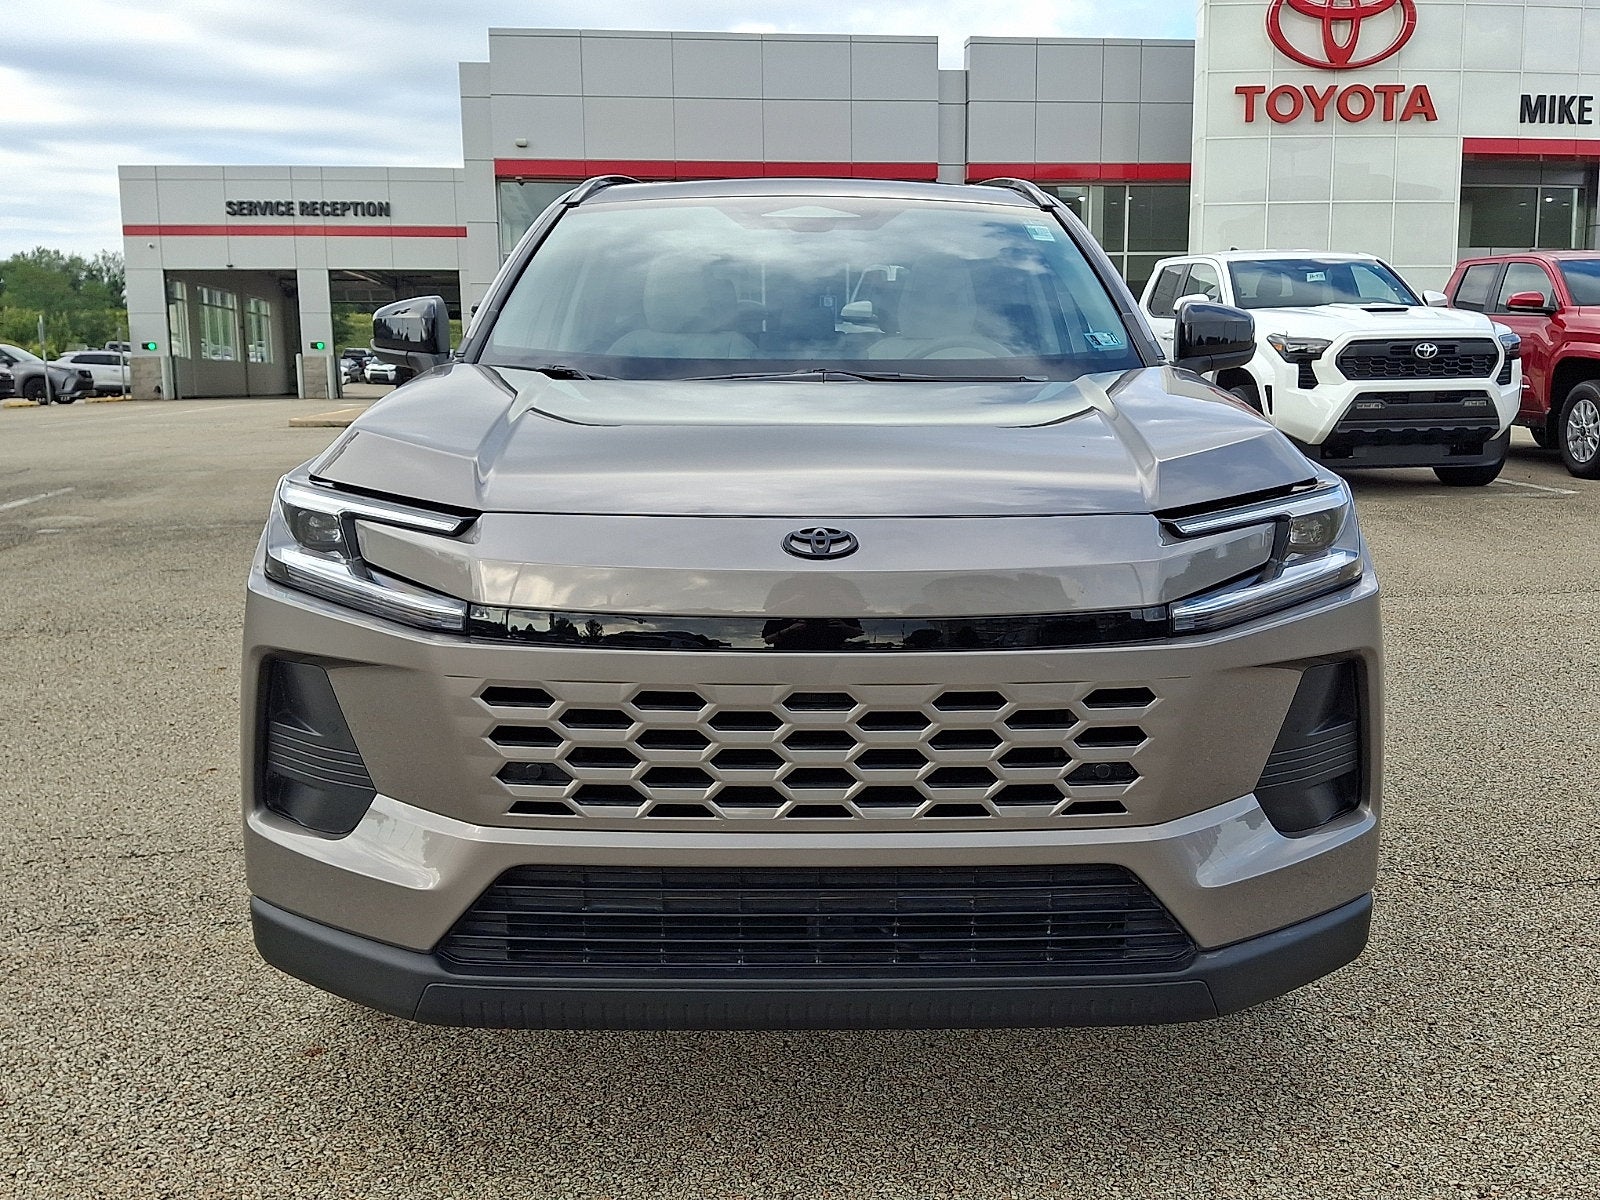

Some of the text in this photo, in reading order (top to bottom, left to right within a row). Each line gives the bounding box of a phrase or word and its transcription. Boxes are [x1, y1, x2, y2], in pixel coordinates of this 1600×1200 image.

[1235, 84, 1438, 123] TOYOTA
[1520, 94, 1594, 125] MIKE
[225, 200, 391, 217] SERVICE RECEPTION
